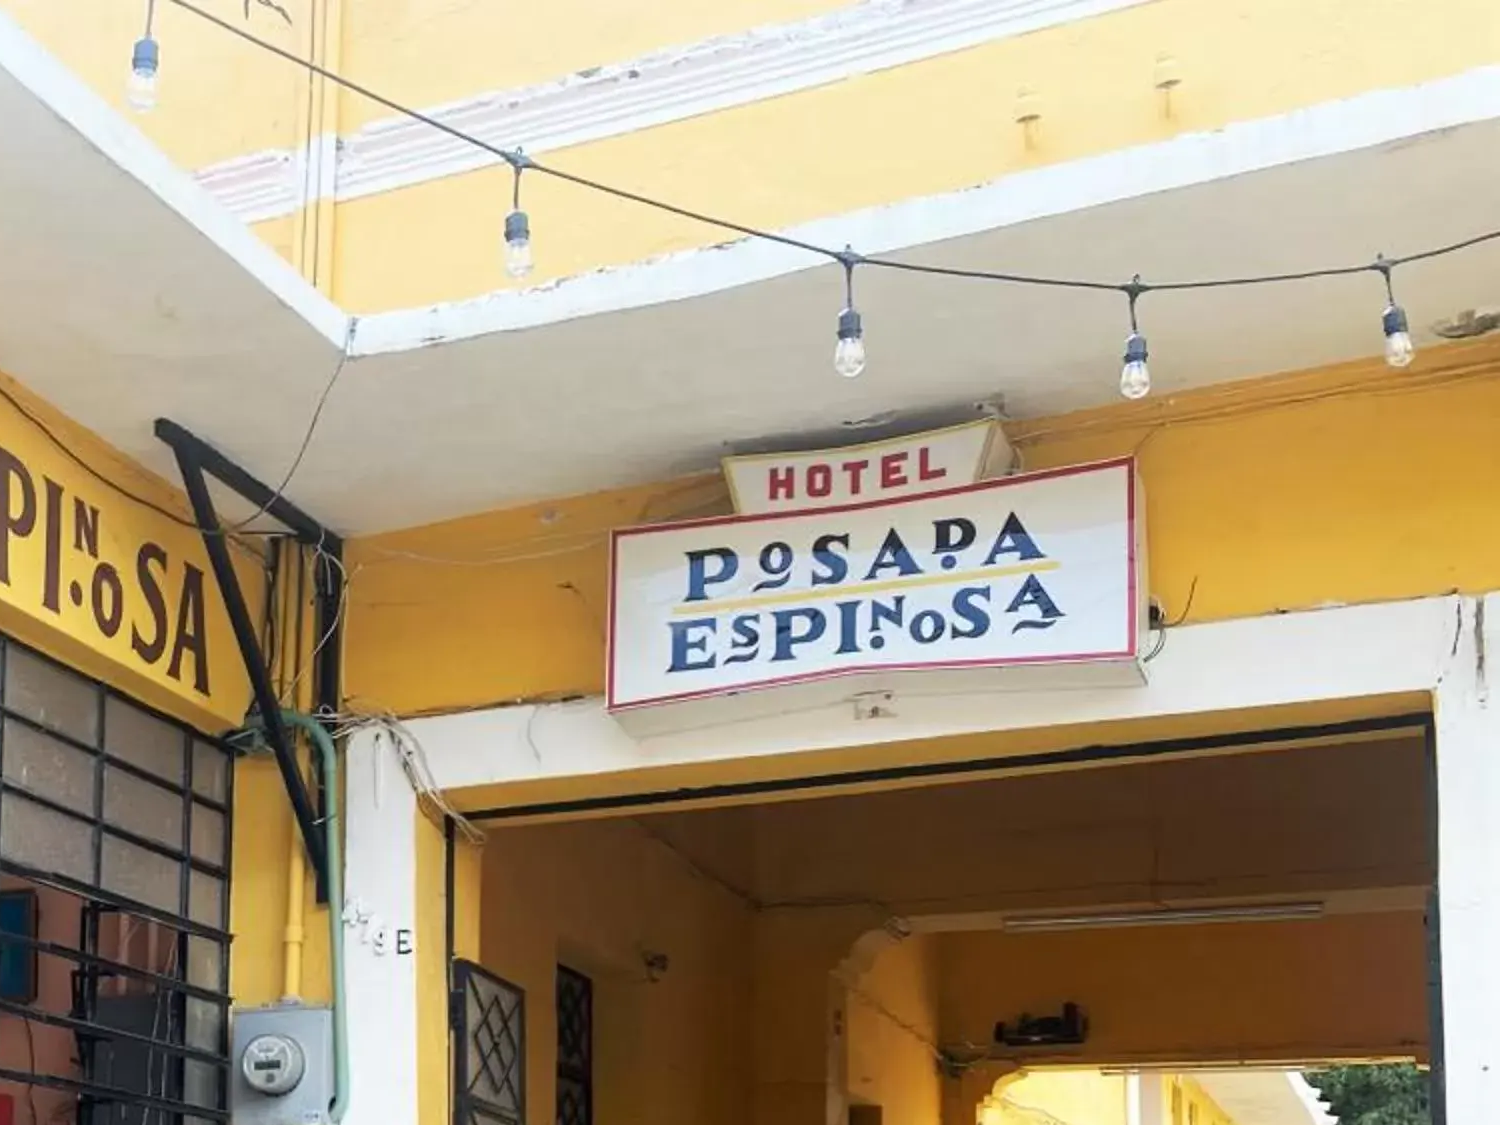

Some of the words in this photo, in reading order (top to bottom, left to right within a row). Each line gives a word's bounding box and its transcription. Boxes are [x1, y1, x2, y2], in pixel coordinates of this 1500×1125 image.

[768, 447, 947, 501] HOTEL
[683, 511, 1048, 602] POSADA
[666, 573, 1065, 673] ESPINOSA
